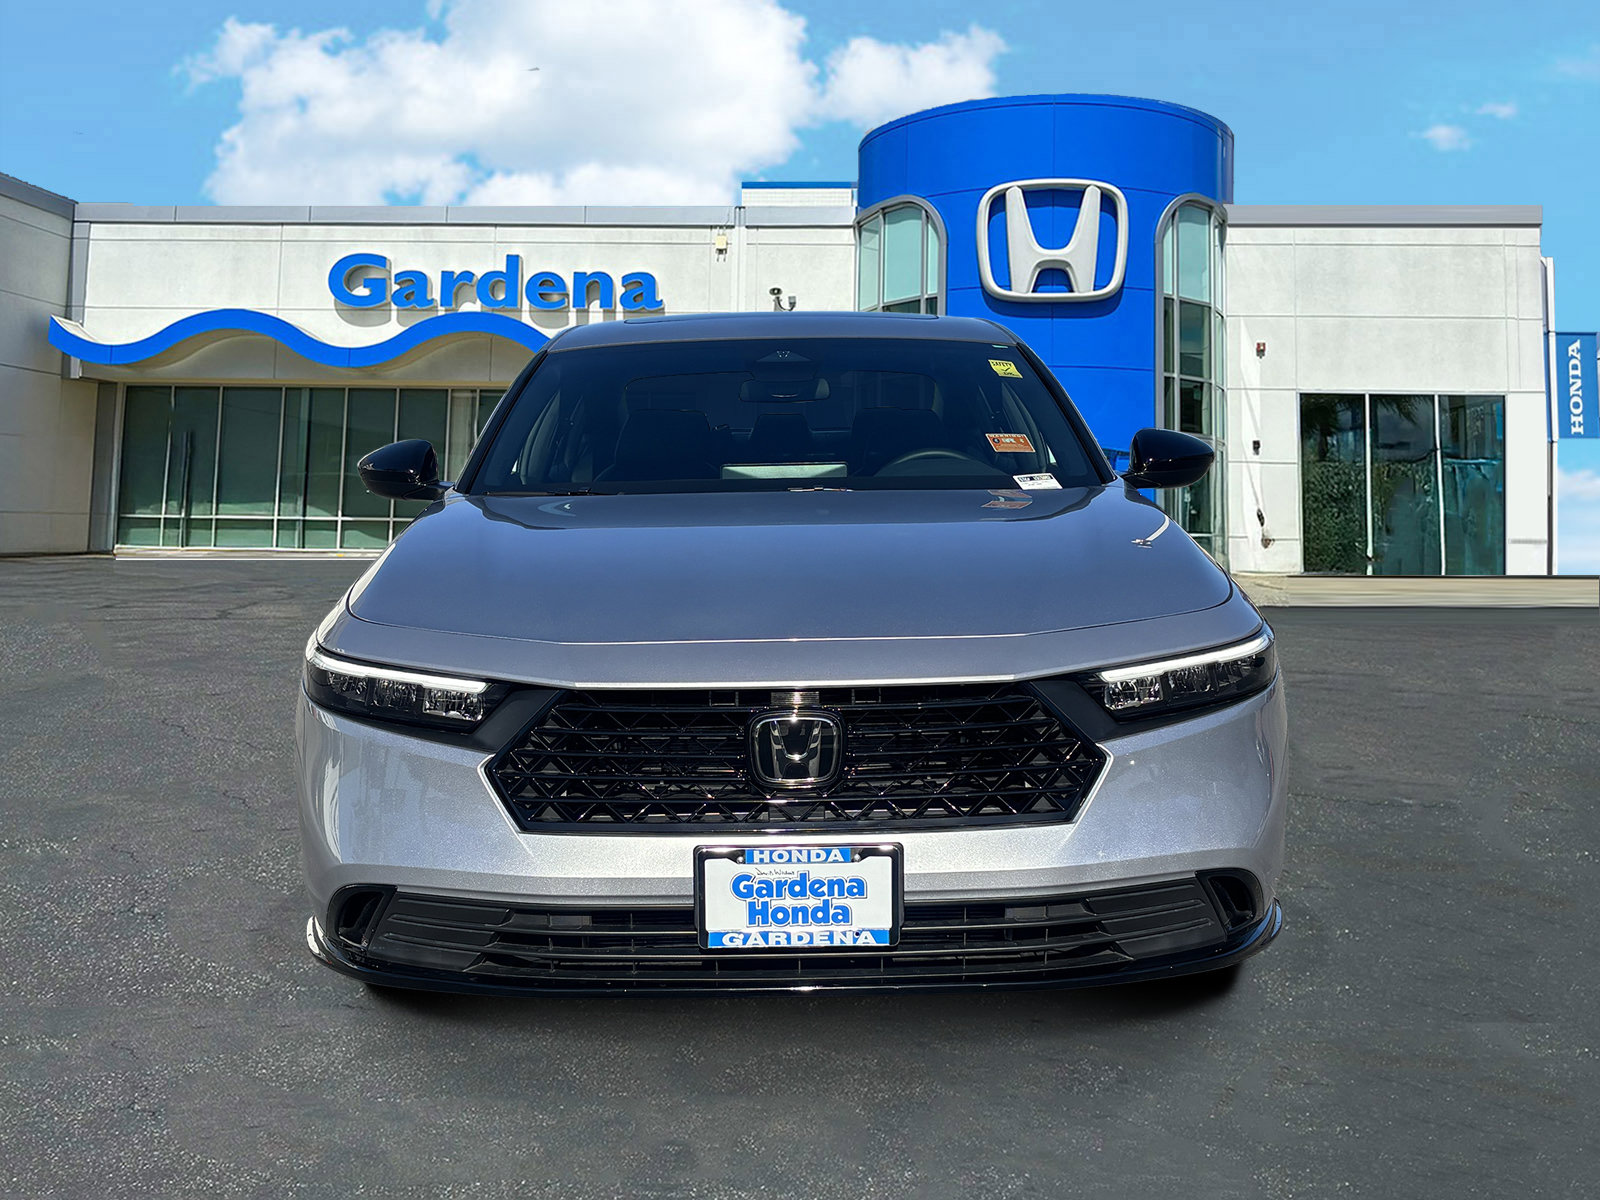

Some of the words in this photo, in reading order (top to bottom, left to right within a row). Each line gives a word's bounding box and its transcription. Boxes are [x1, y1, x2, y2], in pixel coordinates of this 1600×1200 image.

[328, 252, 664, 311] Gardena
[1568, 339, 1584, 435] HONDA
[753, 849, 845, 863] HONDA
[731, 871, 867, 900] Gardena
[747, 898, 852, 926] Honda
[722, 931, 877, 946] GARDENA
